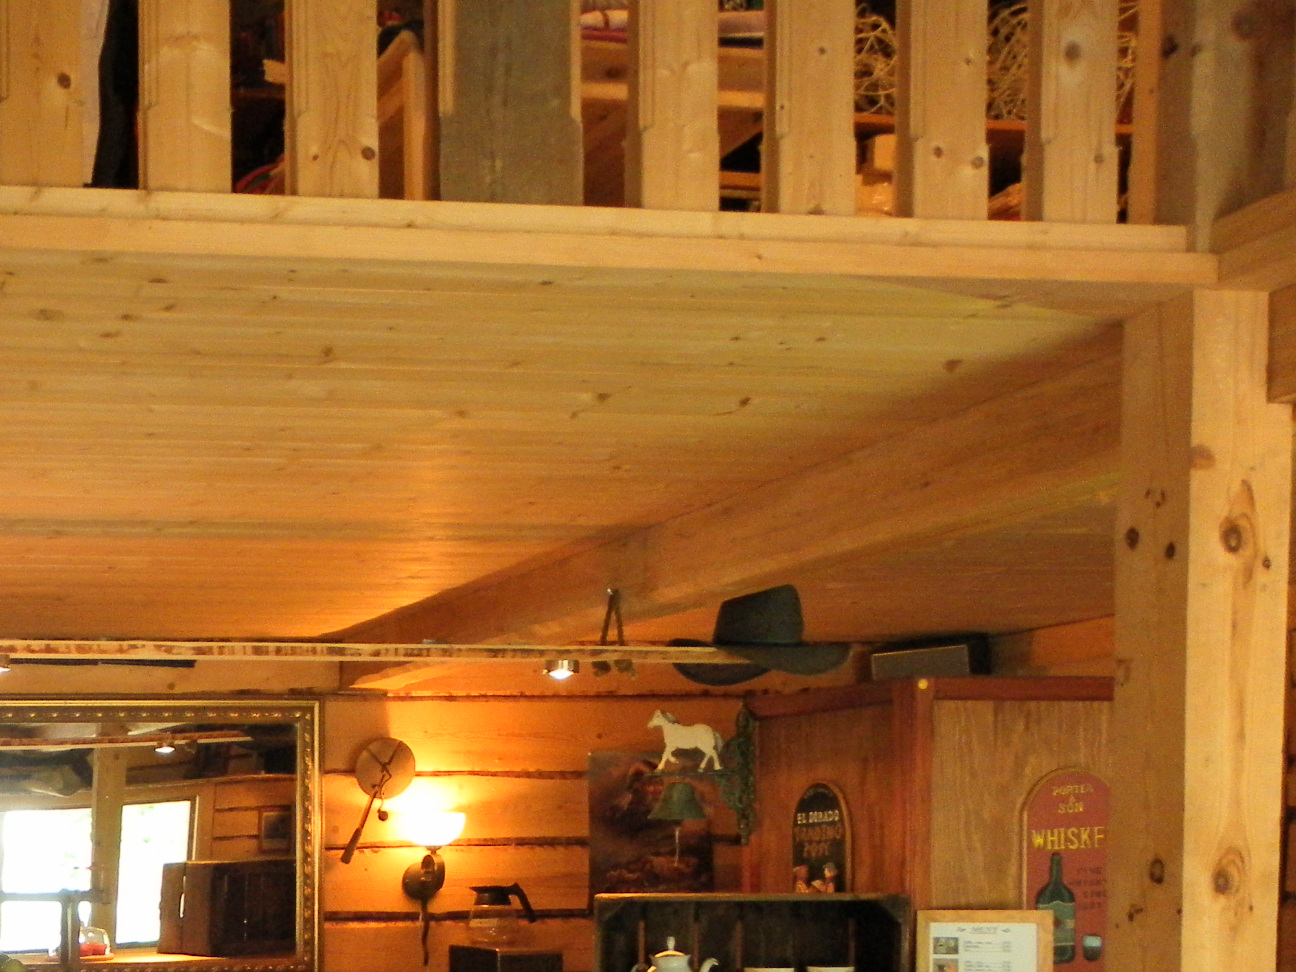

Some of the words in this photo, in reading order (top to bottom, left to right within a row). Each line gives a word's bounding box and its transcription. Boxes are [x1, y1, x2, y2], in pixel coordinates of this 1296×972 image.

[1058, 802, 1084, 814] SON
[797, 813, 806, 825] EL
[808, 809, 840, 824] DORADO
